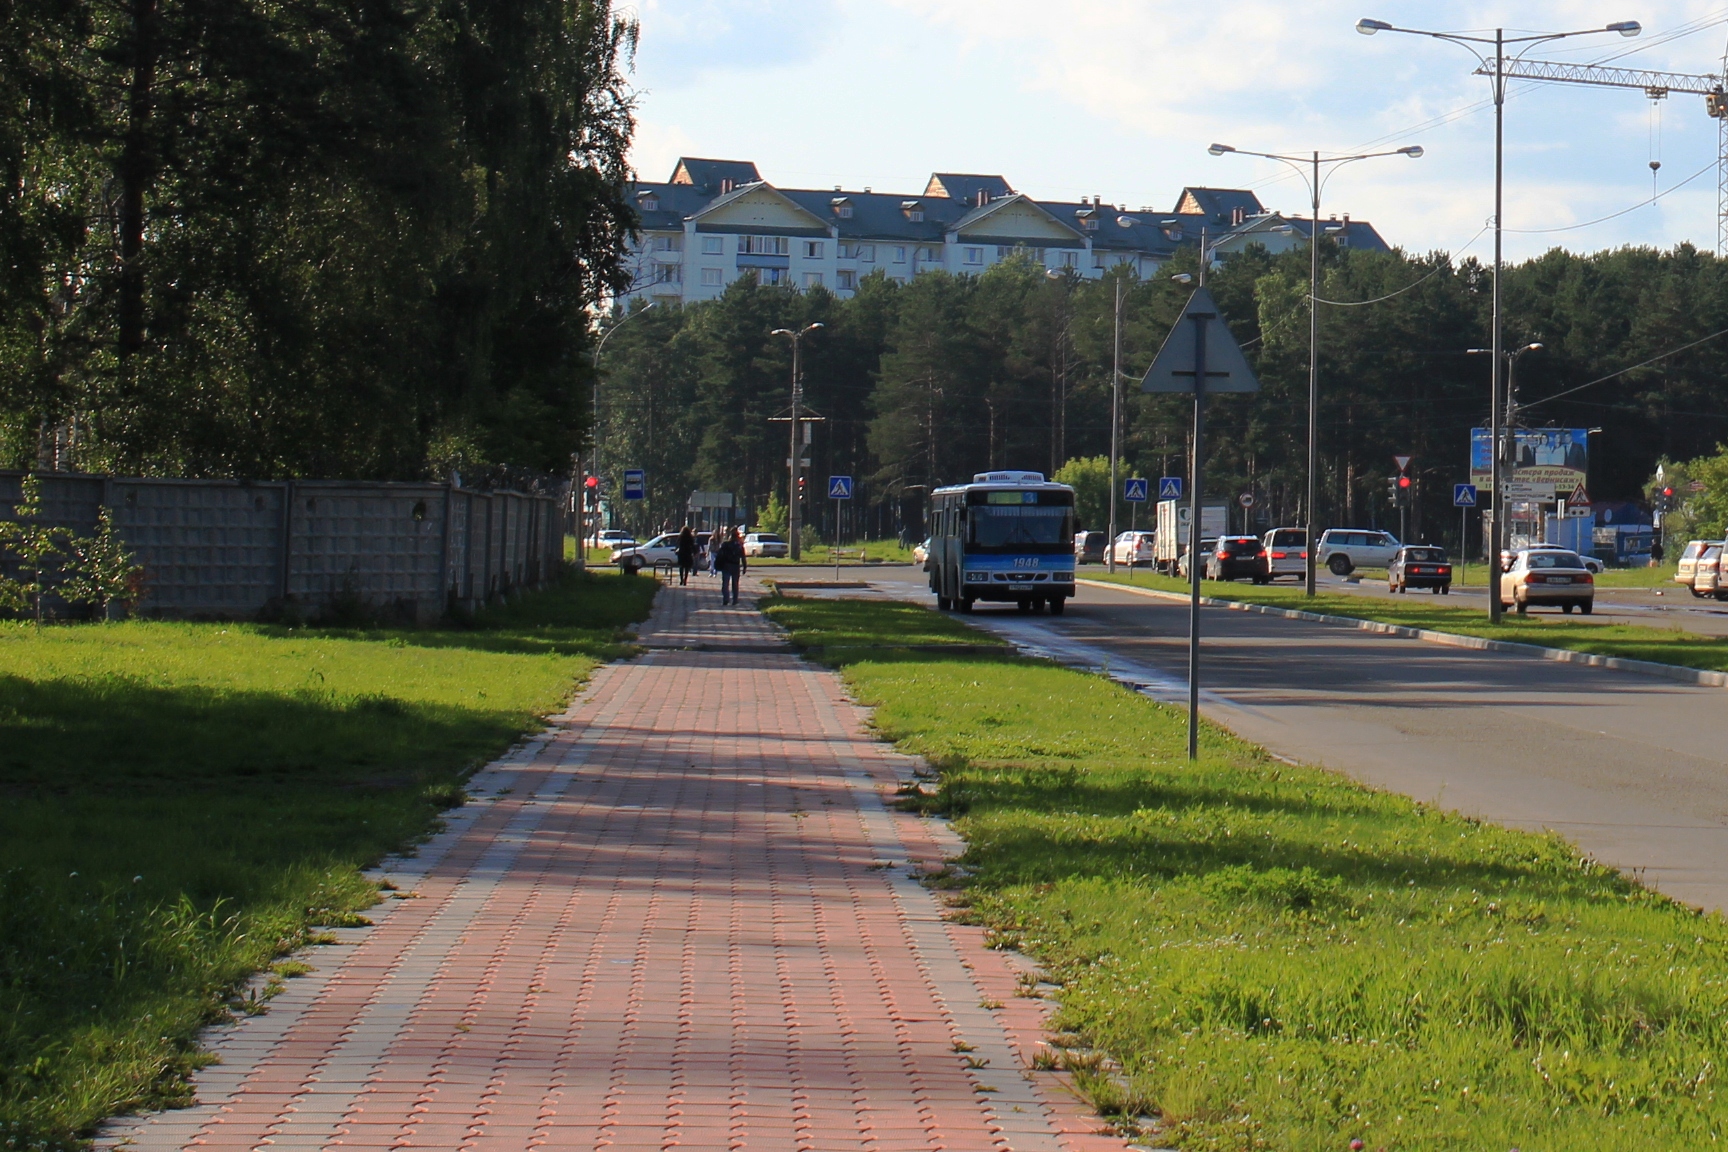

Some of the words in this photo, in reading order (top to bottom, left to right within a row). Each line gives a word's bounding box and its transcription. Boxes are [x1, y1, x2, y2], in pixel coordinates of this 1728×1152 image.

[1513, 469, 1542, 477] астера
[1544, 468, 1575, 476] продаж
[1013, 557, 1039, 568] 1948
